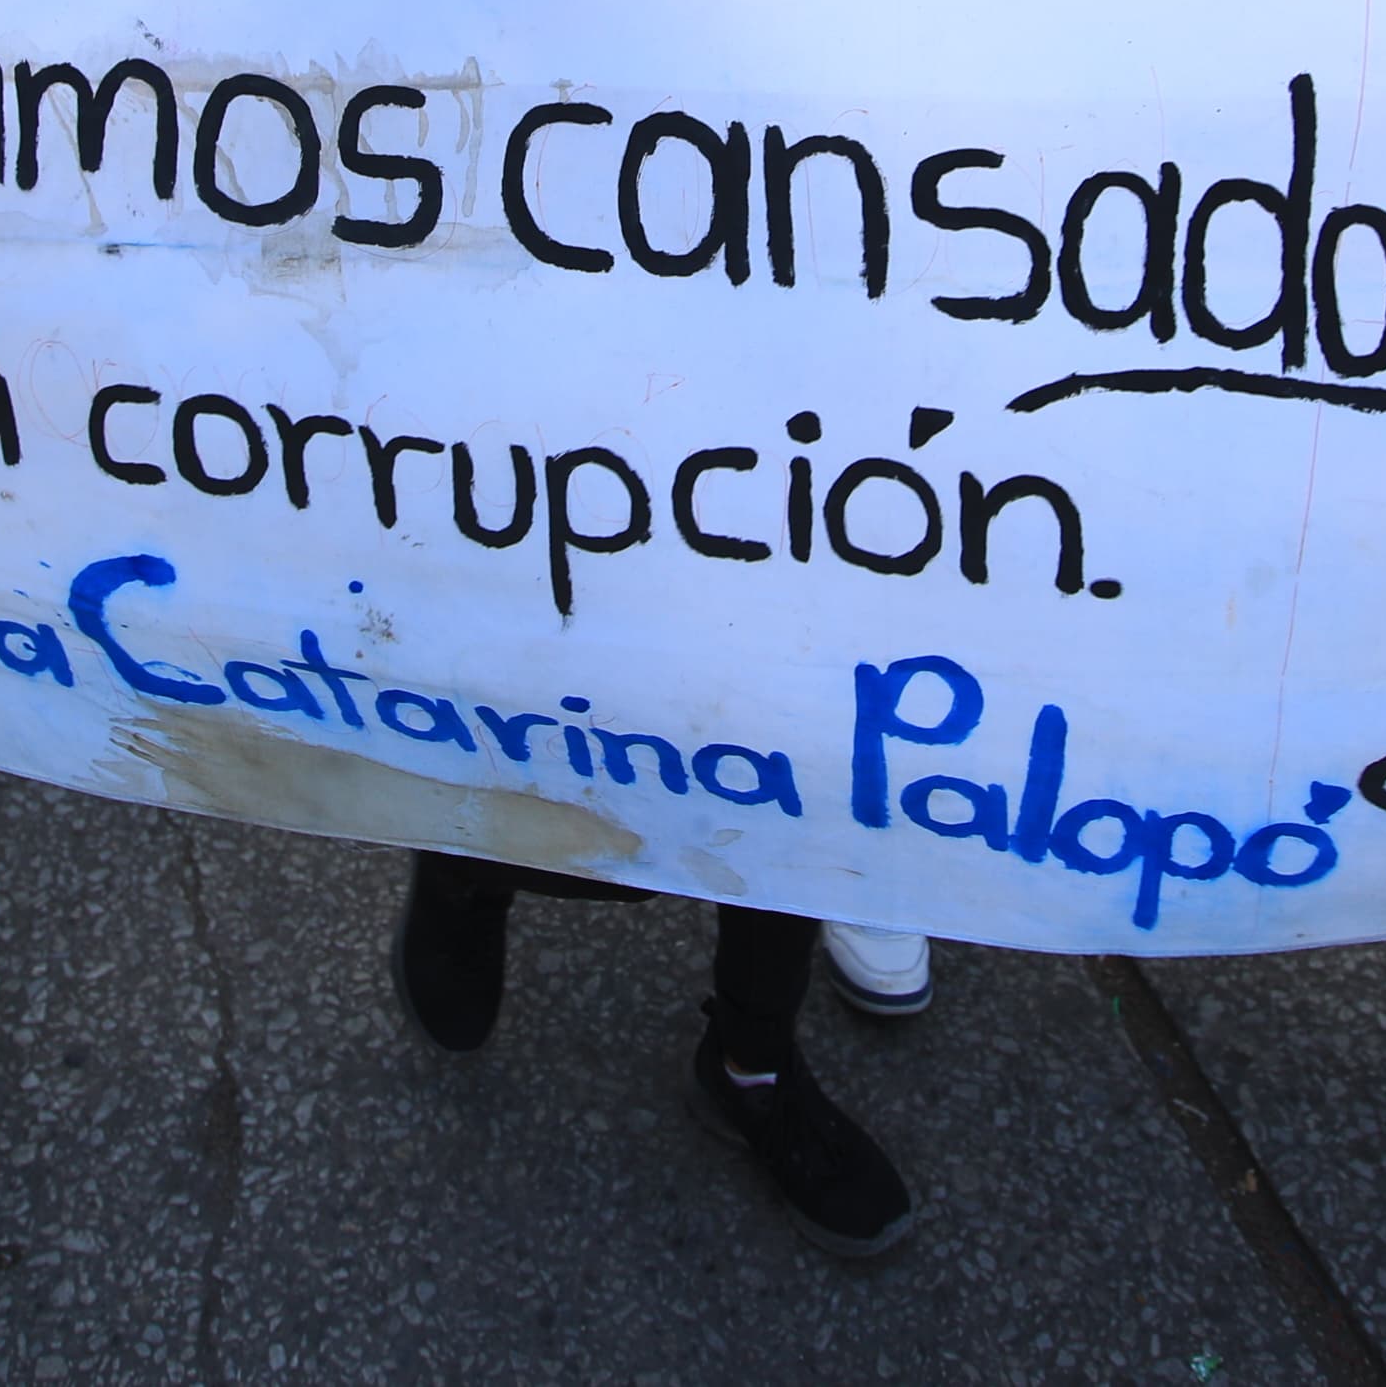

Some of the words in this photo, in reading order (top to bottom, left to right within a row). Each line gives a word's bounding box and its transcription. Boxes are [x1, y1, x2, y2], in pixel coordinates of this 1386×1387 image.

[89, 386, 1123, 619] corrupción.
[68, 554, 801, 817] Catarina
[851, 655, 1352, 930] Palopó
